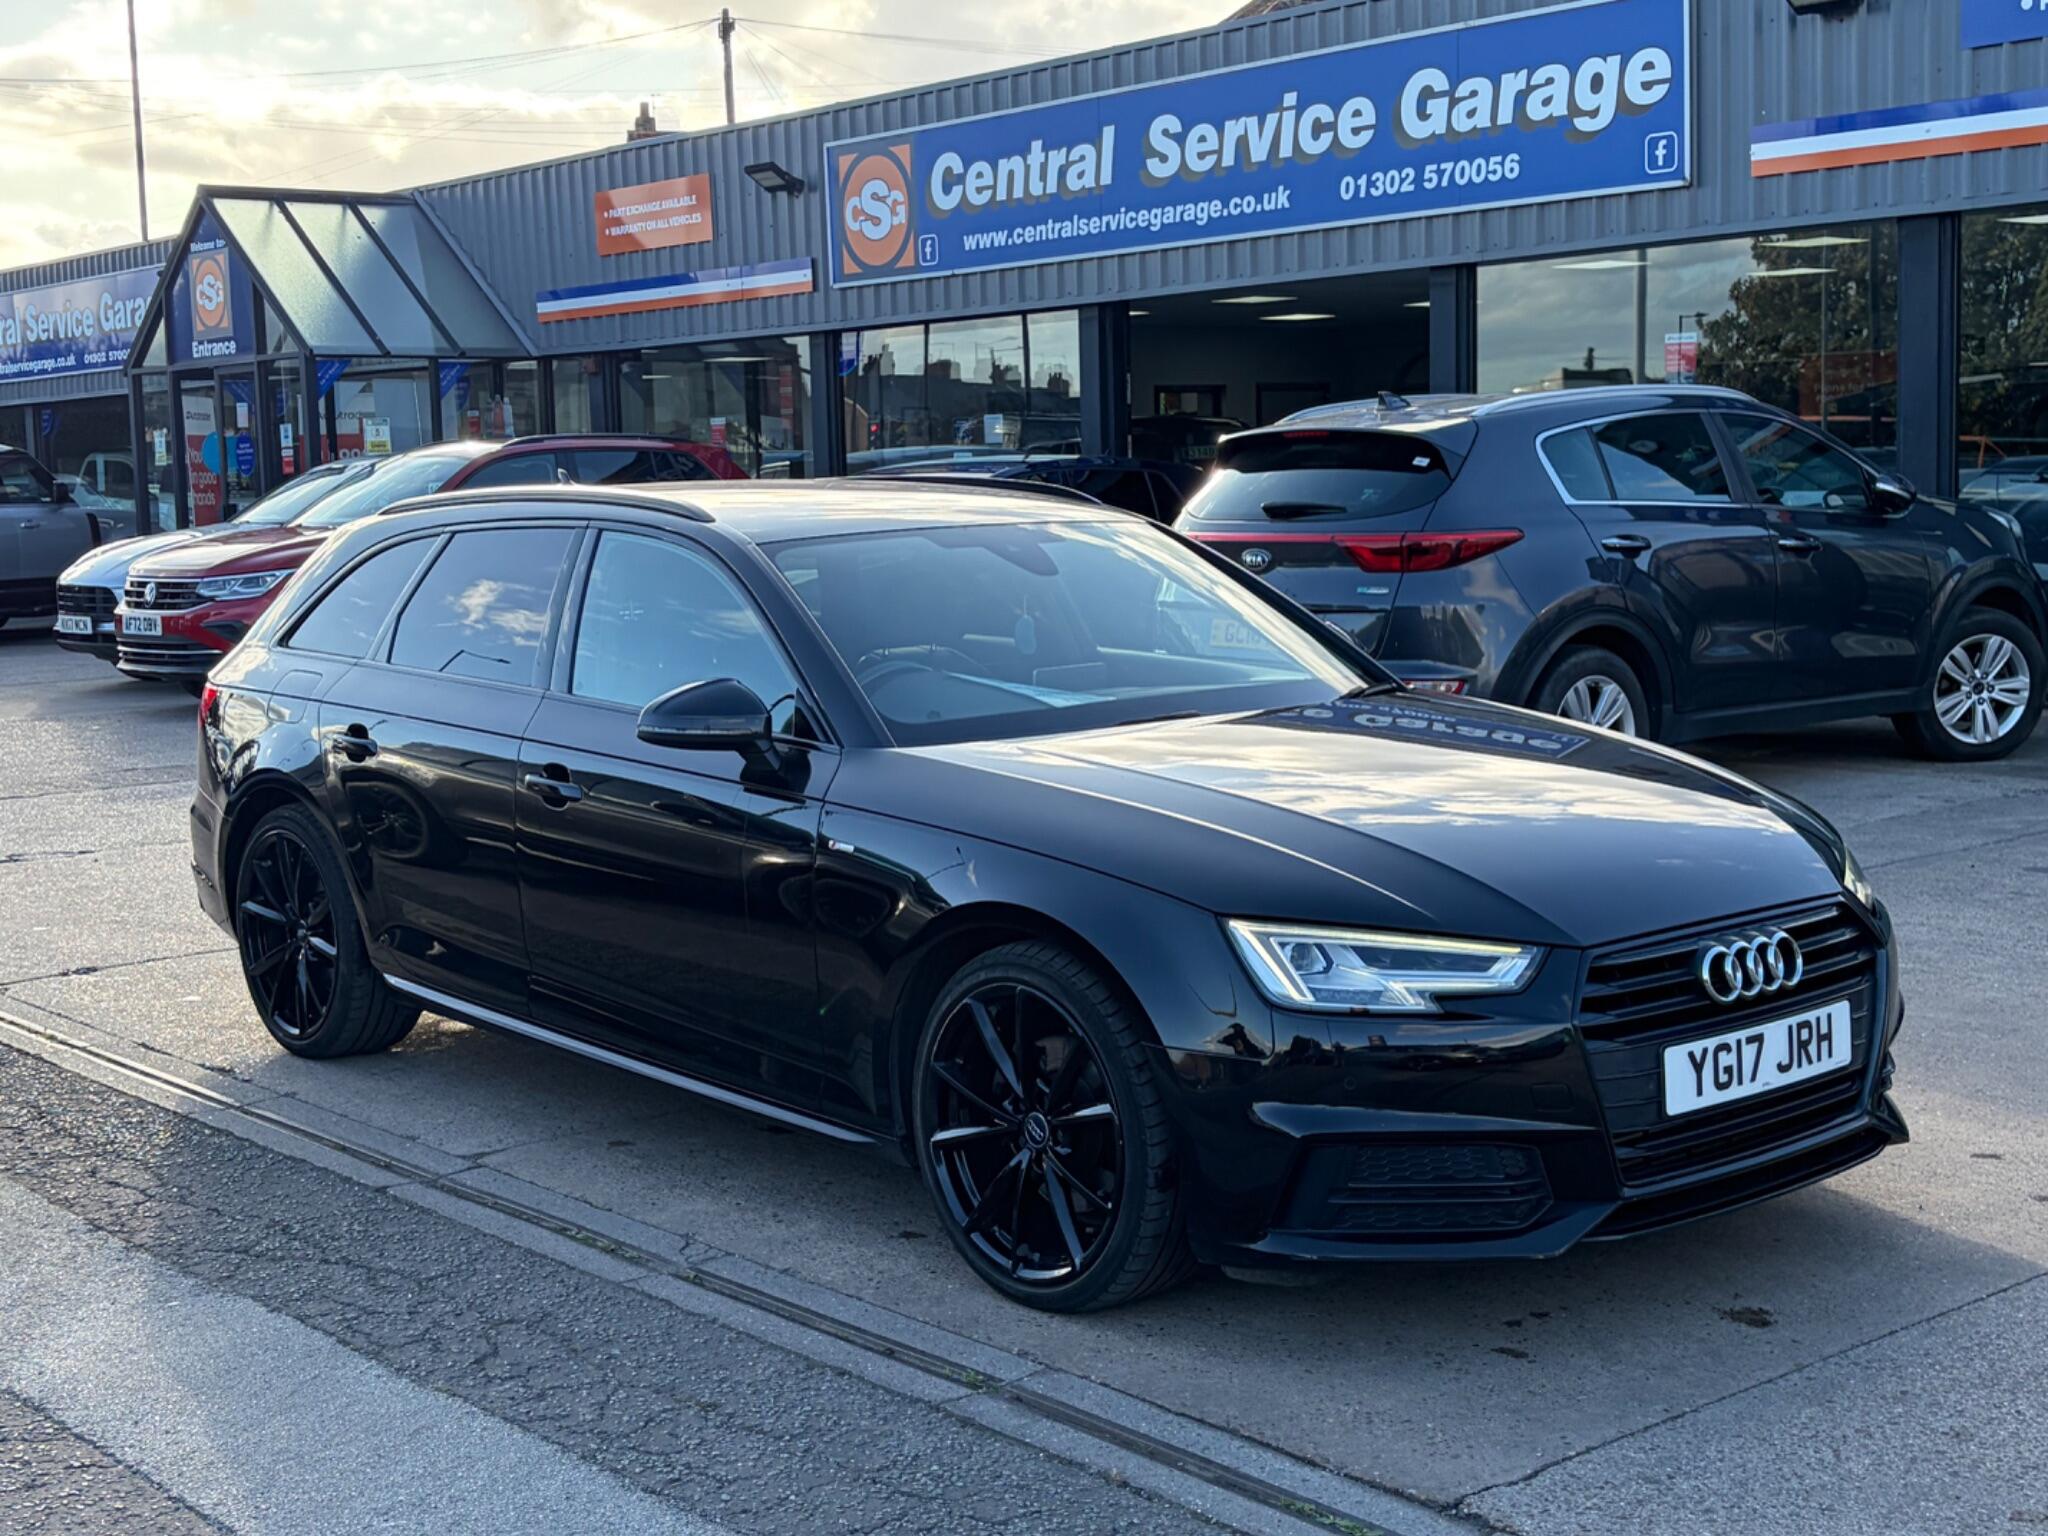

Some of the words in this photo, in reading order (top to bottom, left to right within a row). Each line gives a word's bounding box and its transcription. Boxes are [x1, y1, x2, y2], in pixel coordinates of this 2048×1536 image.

[931, 125, 1115, 210] Central
[1145, 91, 1377, 178] Service
[1400, 47, 1672, 139] Garage
[1340, 167, 1415, 200] 01302
[1423, 153, 1521, 189] 570056
[661, 194, 697, 209] AVAILABLE
[846, 178, 906, 240] CSG
[963, 185, 1291, 250] www.centralservicegarage.co.uk
[611, 221, 647, 237] WARRANTY
[669, 212, 702, 227] VEHICLES
[26, 302, 94, 342] Service
[192, 340, 237, 358] Entrance
[1245, 553, 1264, 567] KIA
[1687, 1032, 1765, 1098] YG17
[1776, 1012, 1833, 1074] JRH
